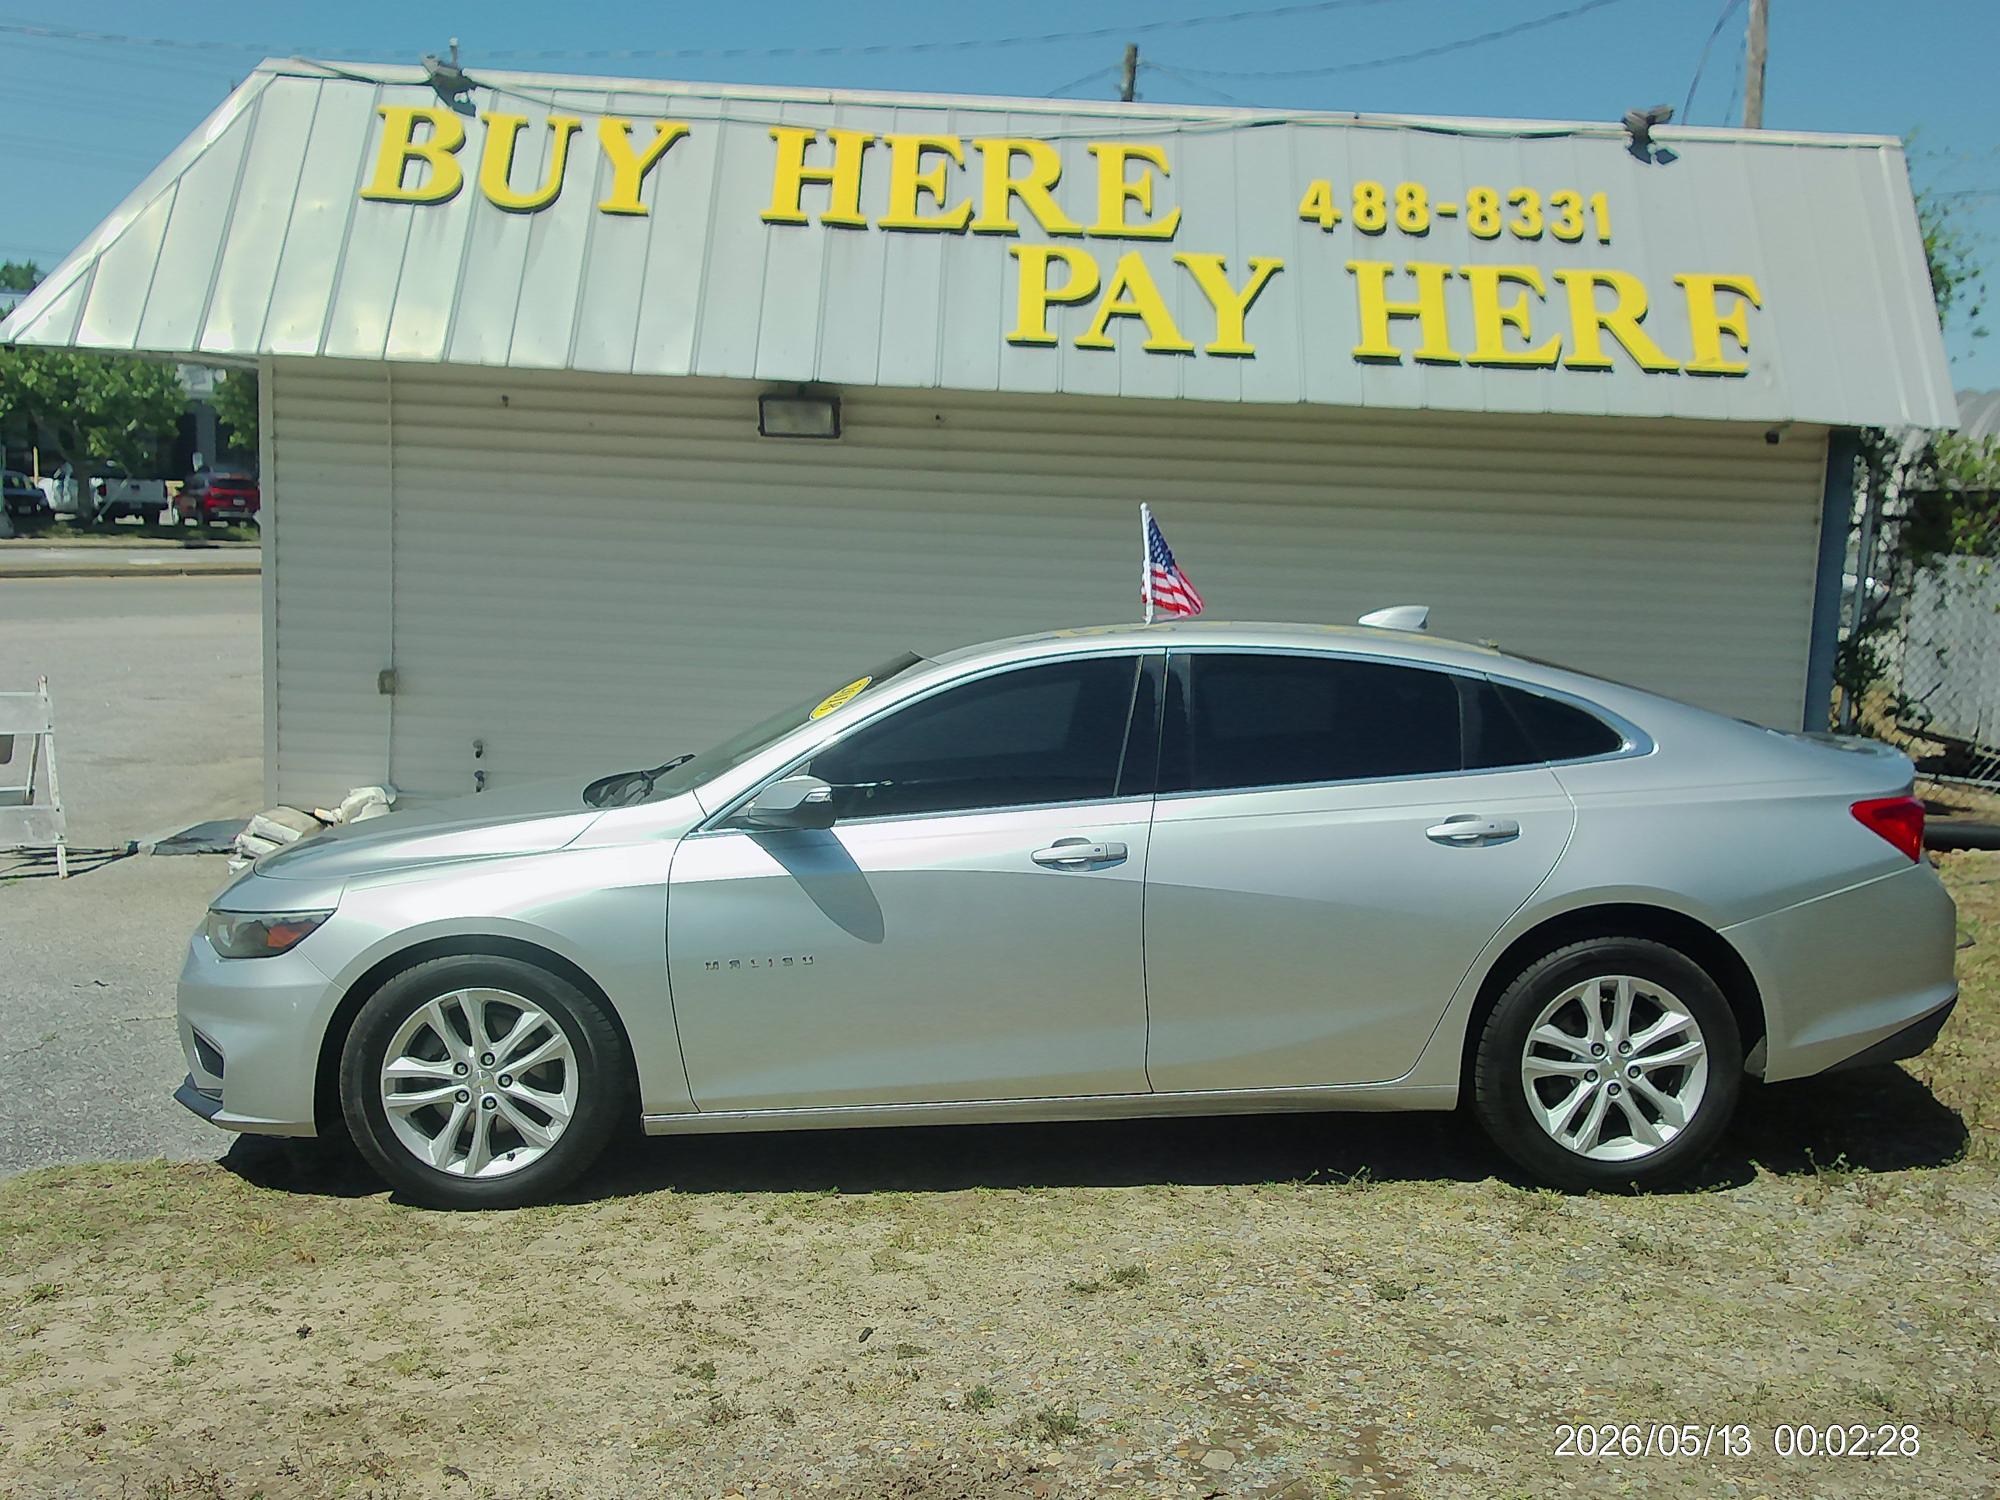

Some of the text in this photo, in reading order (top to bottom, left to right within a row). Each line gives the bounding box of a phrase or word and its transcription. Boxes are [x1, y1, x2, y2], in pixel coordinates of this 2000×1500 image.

[359, 105, 1182, 241] BUY HERE
[1299, 179, 1612, 243] 488-8331
[1006, 244, 1284, 358] PAY
